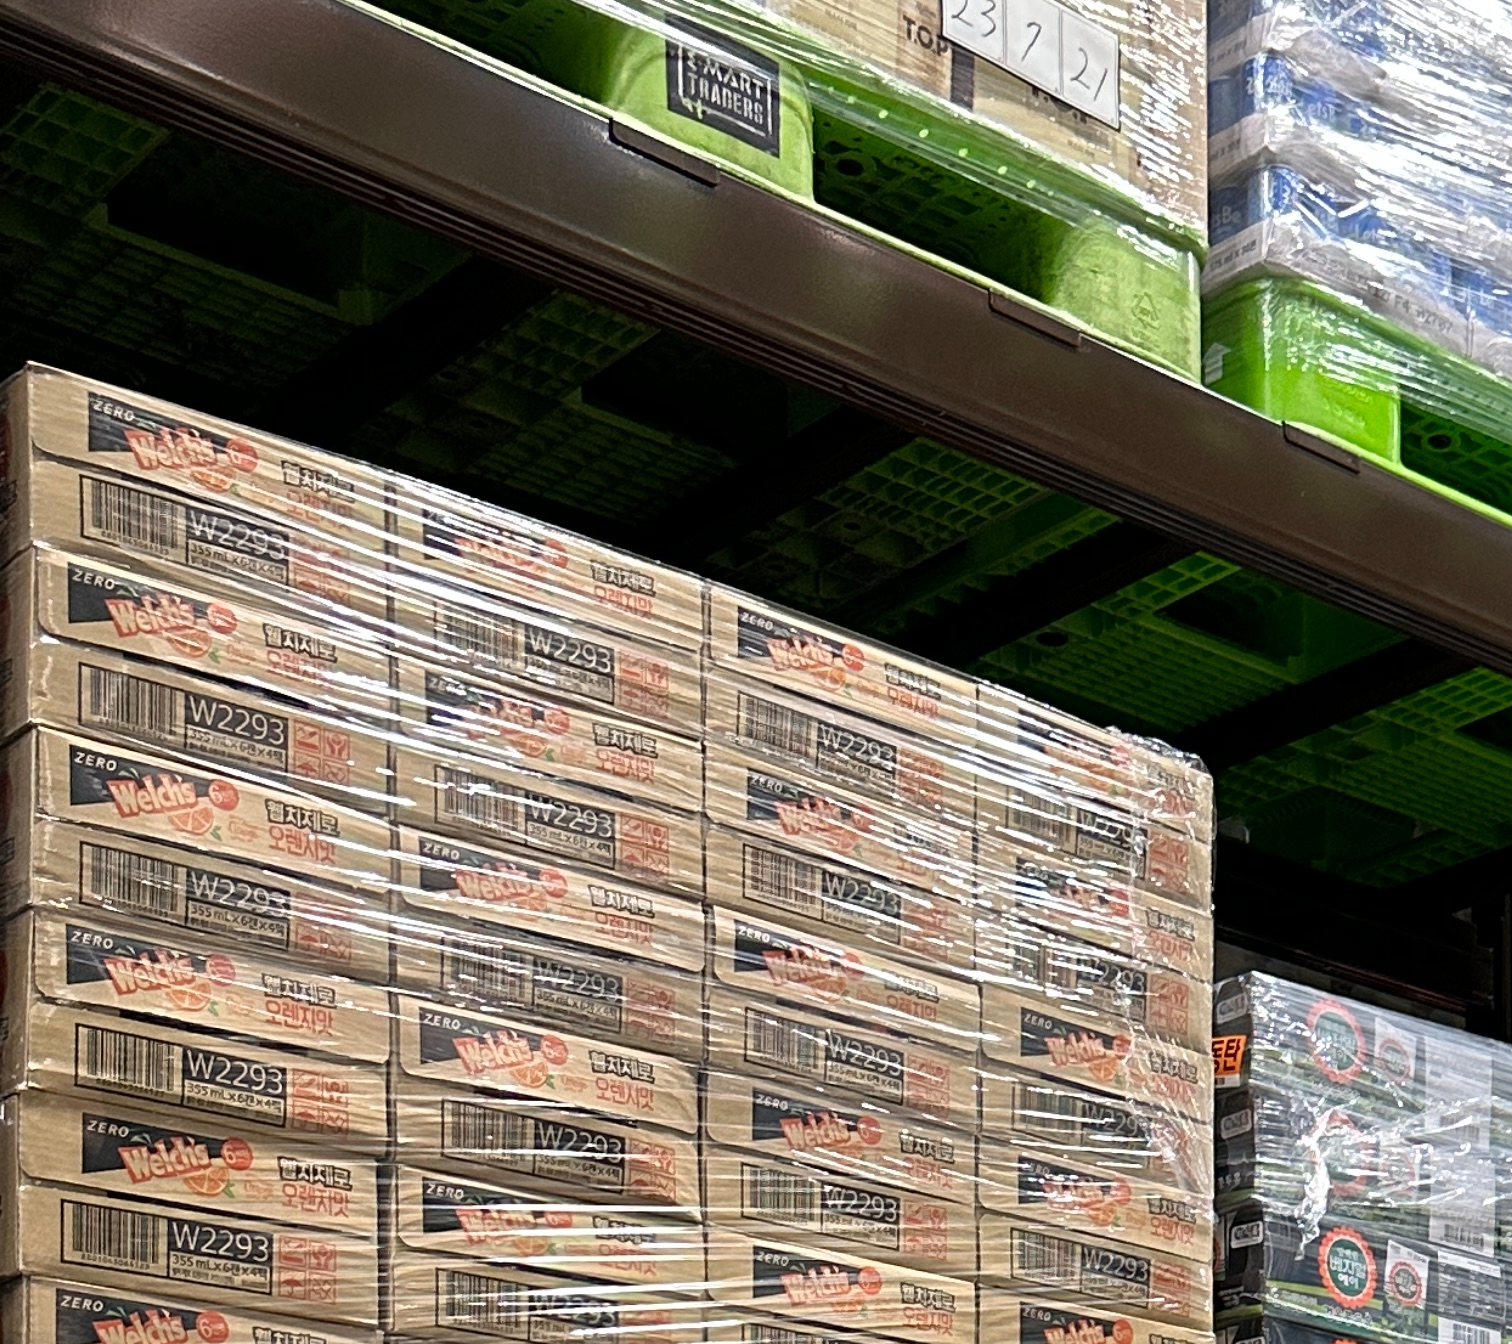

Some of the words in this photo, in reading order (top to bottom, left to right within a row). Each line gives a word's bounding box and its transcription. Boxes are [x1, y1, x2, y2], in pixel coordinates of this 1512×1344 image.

[687, 72, 764, 125] TRADERS
[72, 569, 116, 590] ZERO
[189, 694, 286, 746] W2293
[186, 1049, 283, 1094] W2293
[171, 1219, 270, 1263] W2293
[60, 1296, 104, 1313] ZERO
[1022, 1306, 1051, 1322] ZERO
